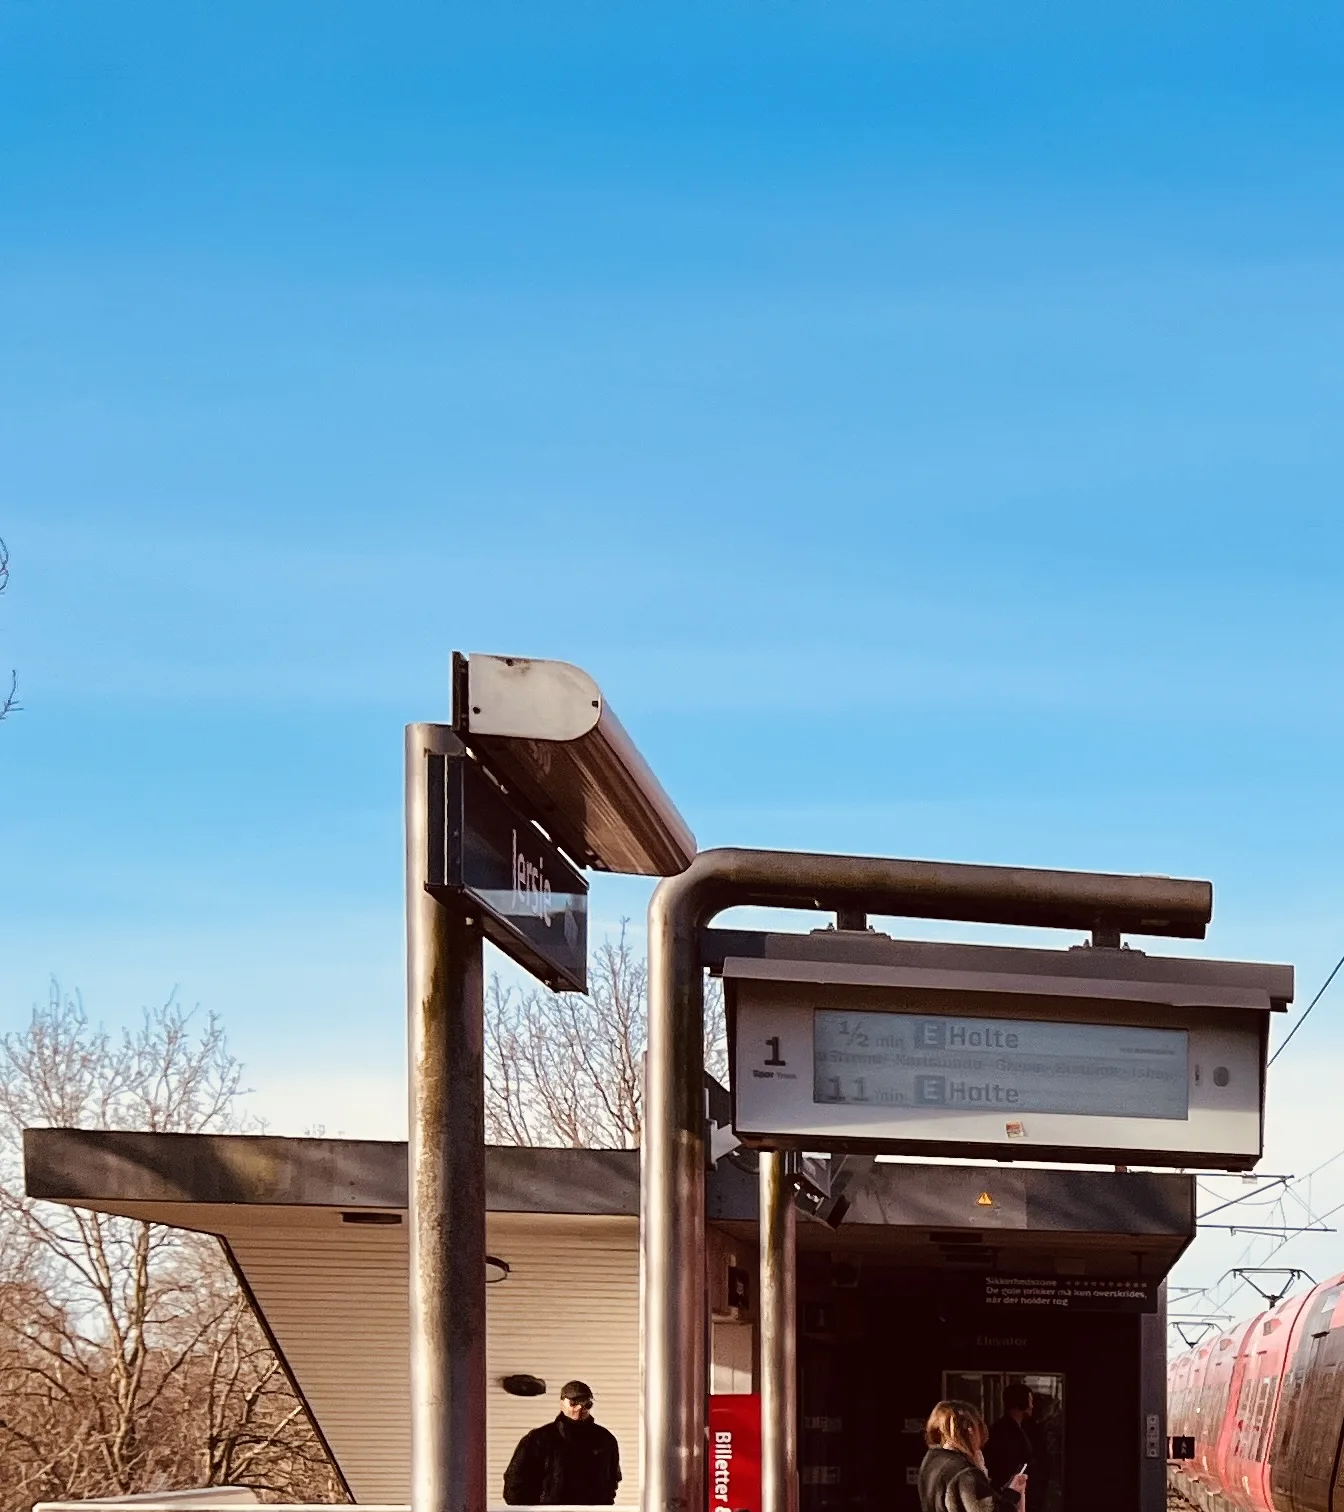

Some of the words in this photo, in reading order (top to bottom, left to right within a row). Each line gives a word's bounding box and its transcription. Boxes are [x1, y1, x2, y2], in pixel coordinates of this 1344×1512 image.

[511, 828, 552, 928] Jersie
[764, 1036, 786, 1067] 1
[923, 1024, 938, 1045] E
[950, 1025, 1019, 1049] Holte
[827, 1076, 870, 1101] 11
[923, 1079, 938, 1100] E
[950, 1081, 1019, 1104] Holte
[714, 1431, 733, 1503] Billetter
